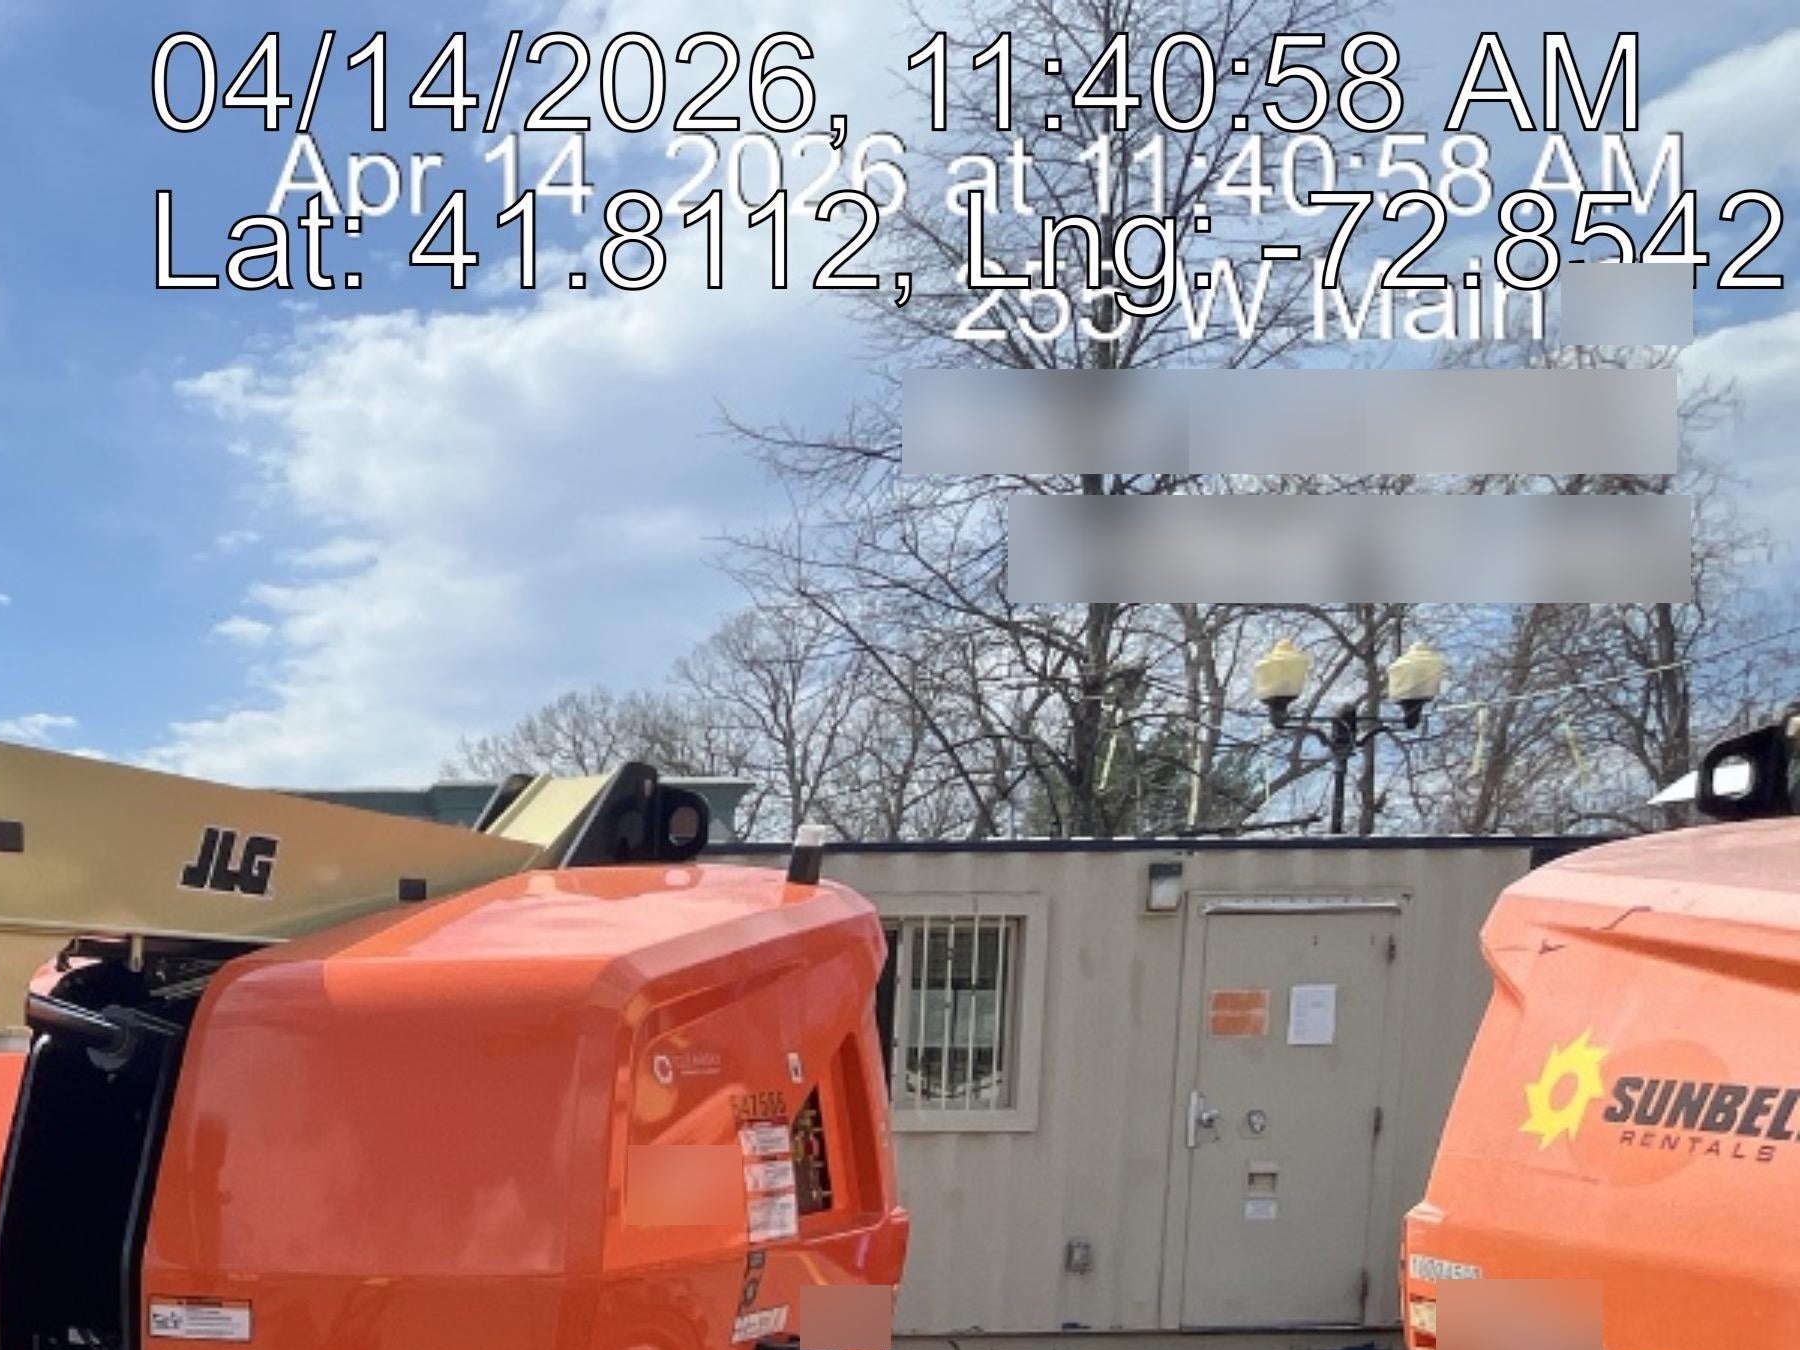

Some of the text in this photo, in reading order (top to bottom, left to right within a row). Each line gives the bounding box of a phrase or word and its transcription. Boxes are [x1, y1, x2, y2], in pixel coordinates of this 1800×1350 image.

[177, 824, 281, 899] JLG
[1603, 1076, 1800, 1141] SUNBEL
[1619, 1129, 1777, 1162] RENTALS
